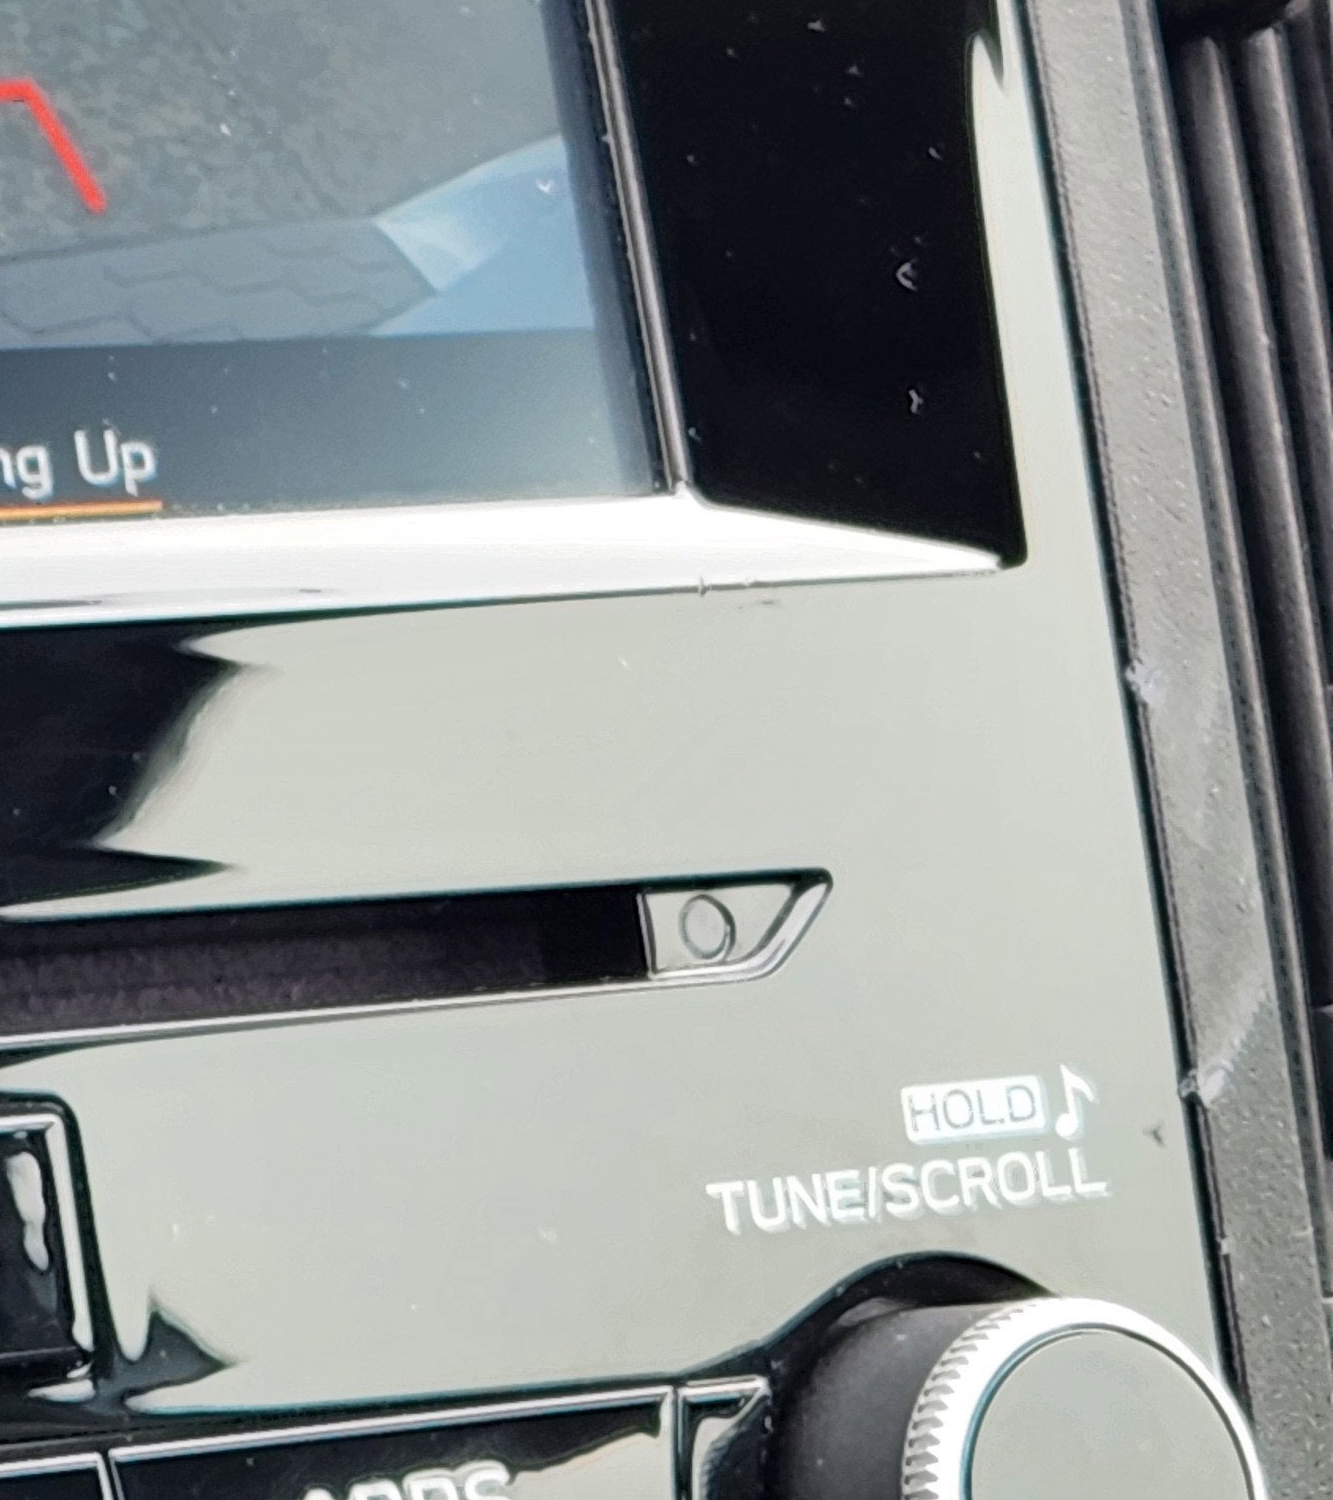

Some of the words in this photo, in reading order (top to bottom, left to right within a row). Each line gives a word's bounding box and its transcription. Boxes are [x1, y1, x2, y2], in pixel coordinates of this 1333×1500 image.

[73, 428, 158, 496] Up
[905, 1082, 1041, 1136] HOLD
[705, 1147, 1112, 1234] TUNE/SCROLL
